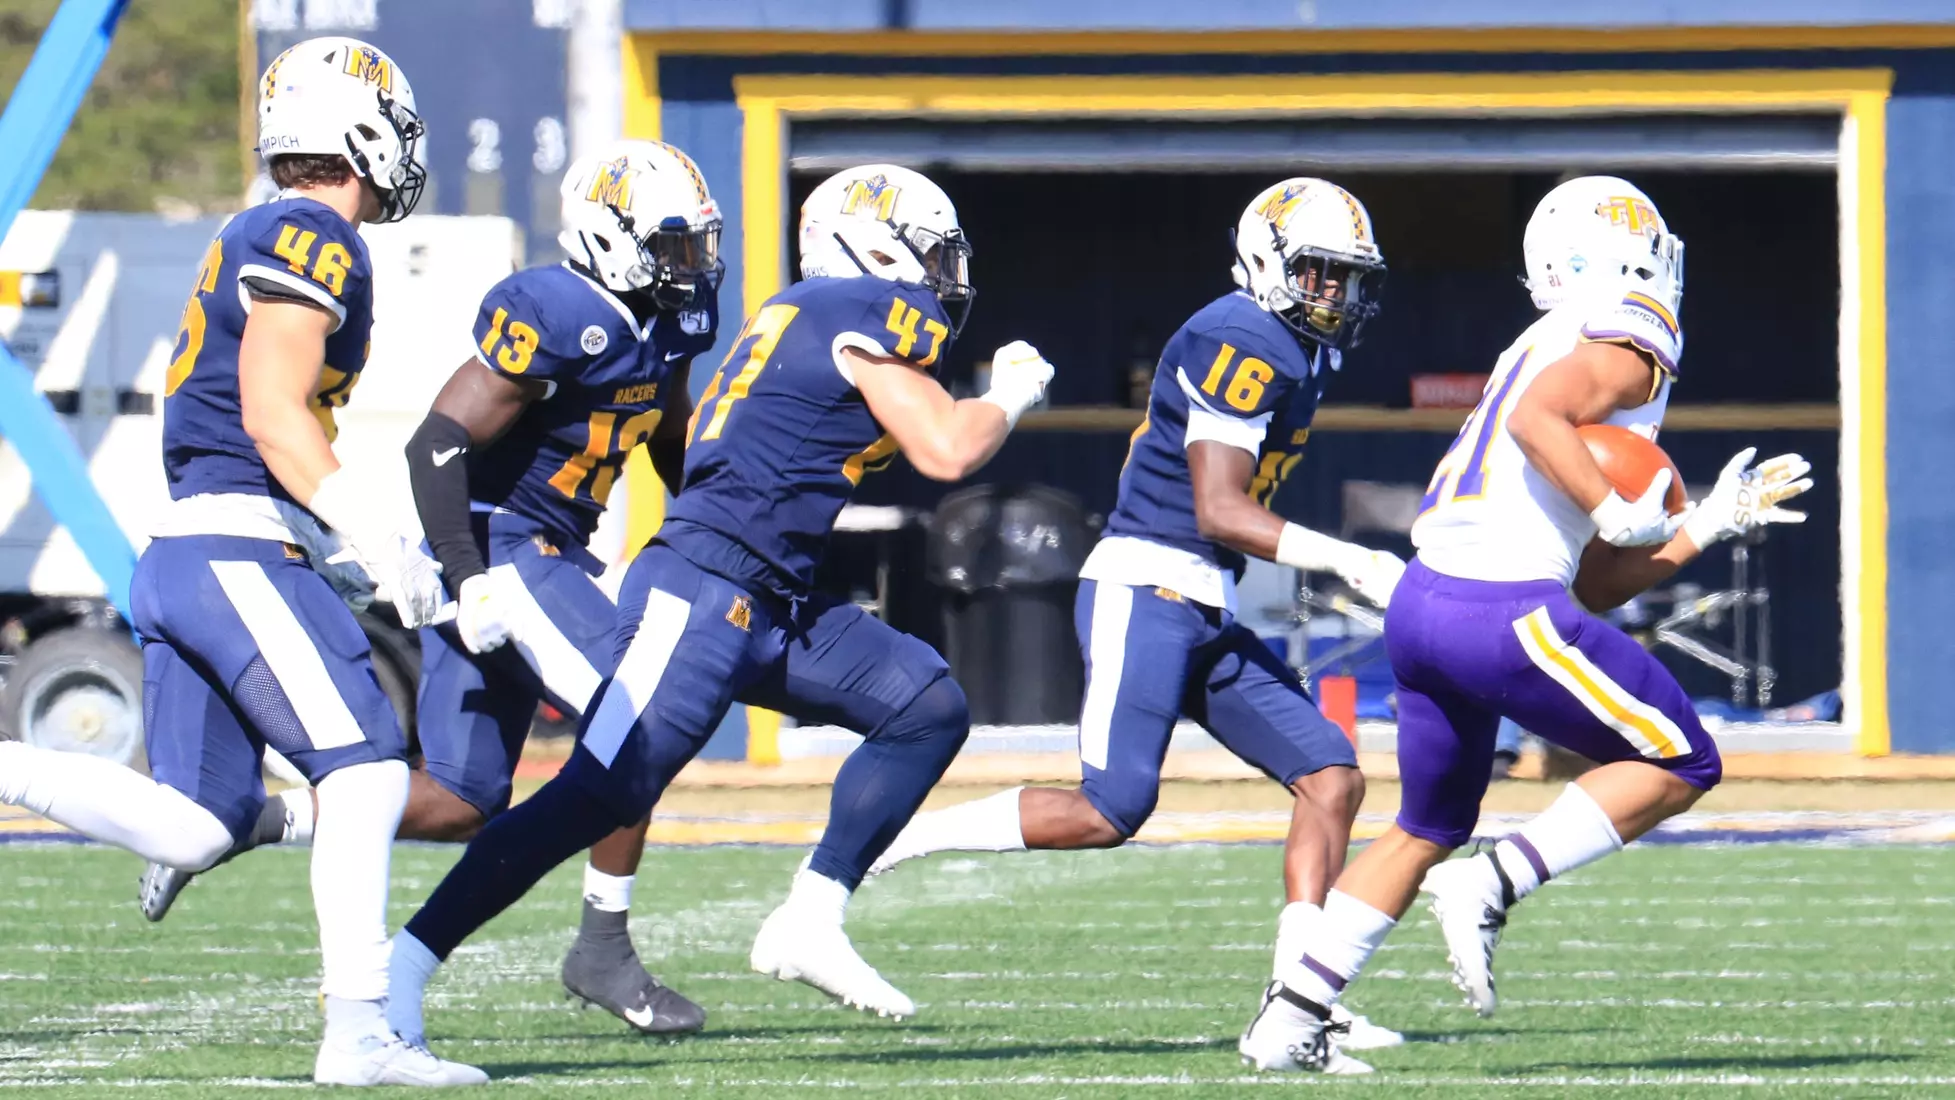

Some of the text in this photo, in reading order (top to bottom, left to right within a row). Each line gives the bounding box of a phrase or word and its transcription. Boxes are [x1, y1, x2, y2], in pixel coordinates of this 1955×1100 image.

[262, 135, 300, 150] MPICH
[274, 224, 352, 296] 46
[481, 307, 539, 374] 13
[886, 297, 948, 366] 47
[613, 383, 658, 404] RACERS
[1201, 342, 1274, 412] 16
